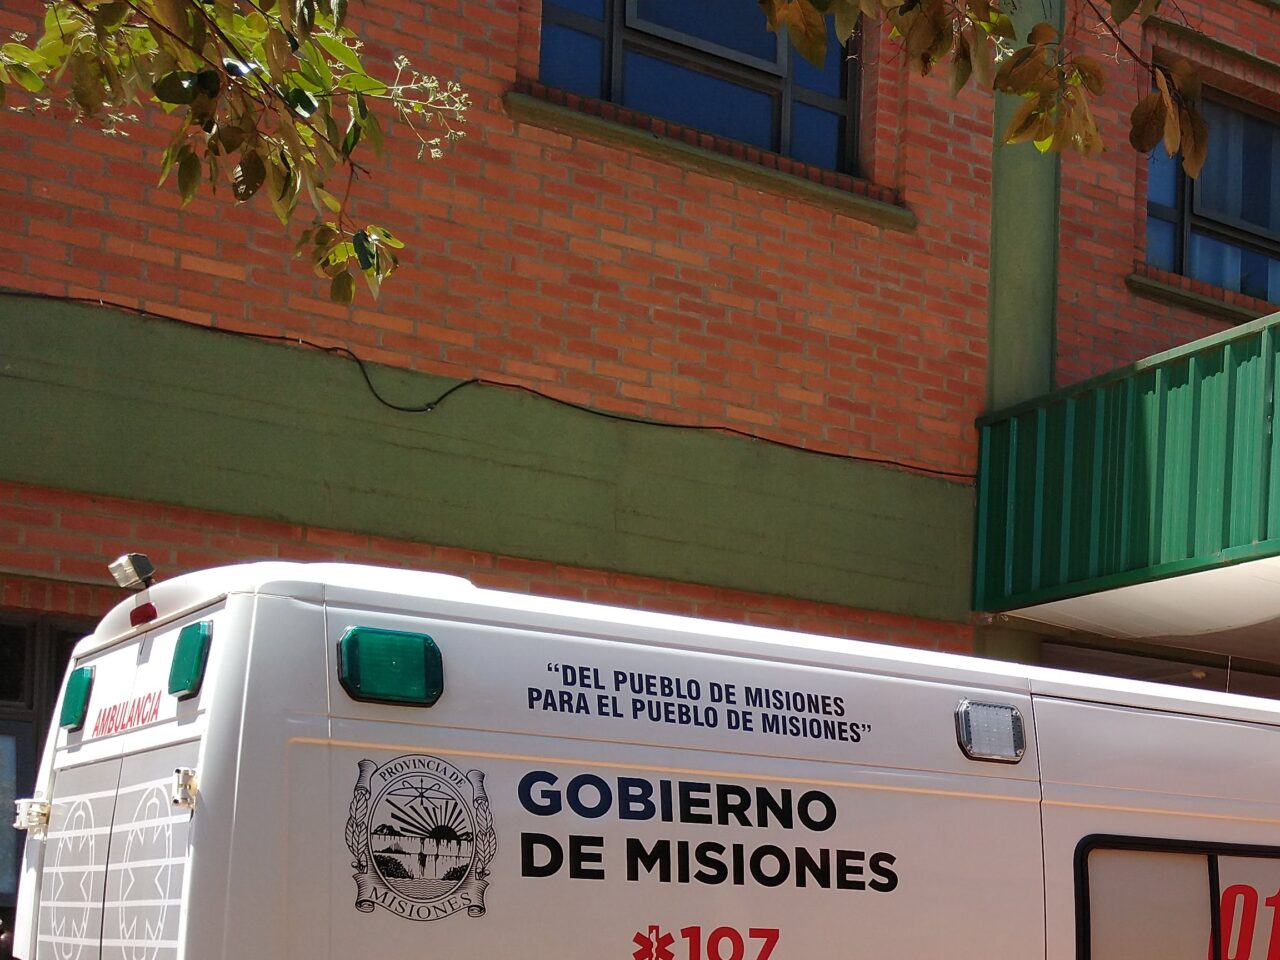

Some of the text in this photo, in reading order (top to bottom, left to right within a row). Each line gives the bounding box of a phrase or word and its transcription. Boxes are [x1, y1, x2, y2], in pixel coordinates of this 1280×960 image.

[92, 690, 162, 738] AMBULANCIA
[527, 687, 589, 715] PARA
[597, 694, 624, 718] EL
[632, 696, 718, 728] PUEBLO
[727, 710, 753, 732] DE
[614, 670, 701, 701] PUEBLO
[709, 682, 736, 706] DE
[745, 686, 845, 718] MISIONES
[378, 758, 467, 789] PROVINCIA DE
[517, 770, 837, 832] GOBIERNO
[520, 832, 899, 893] DE MISIONES
[369, 886, 473, 919] MISIONES
